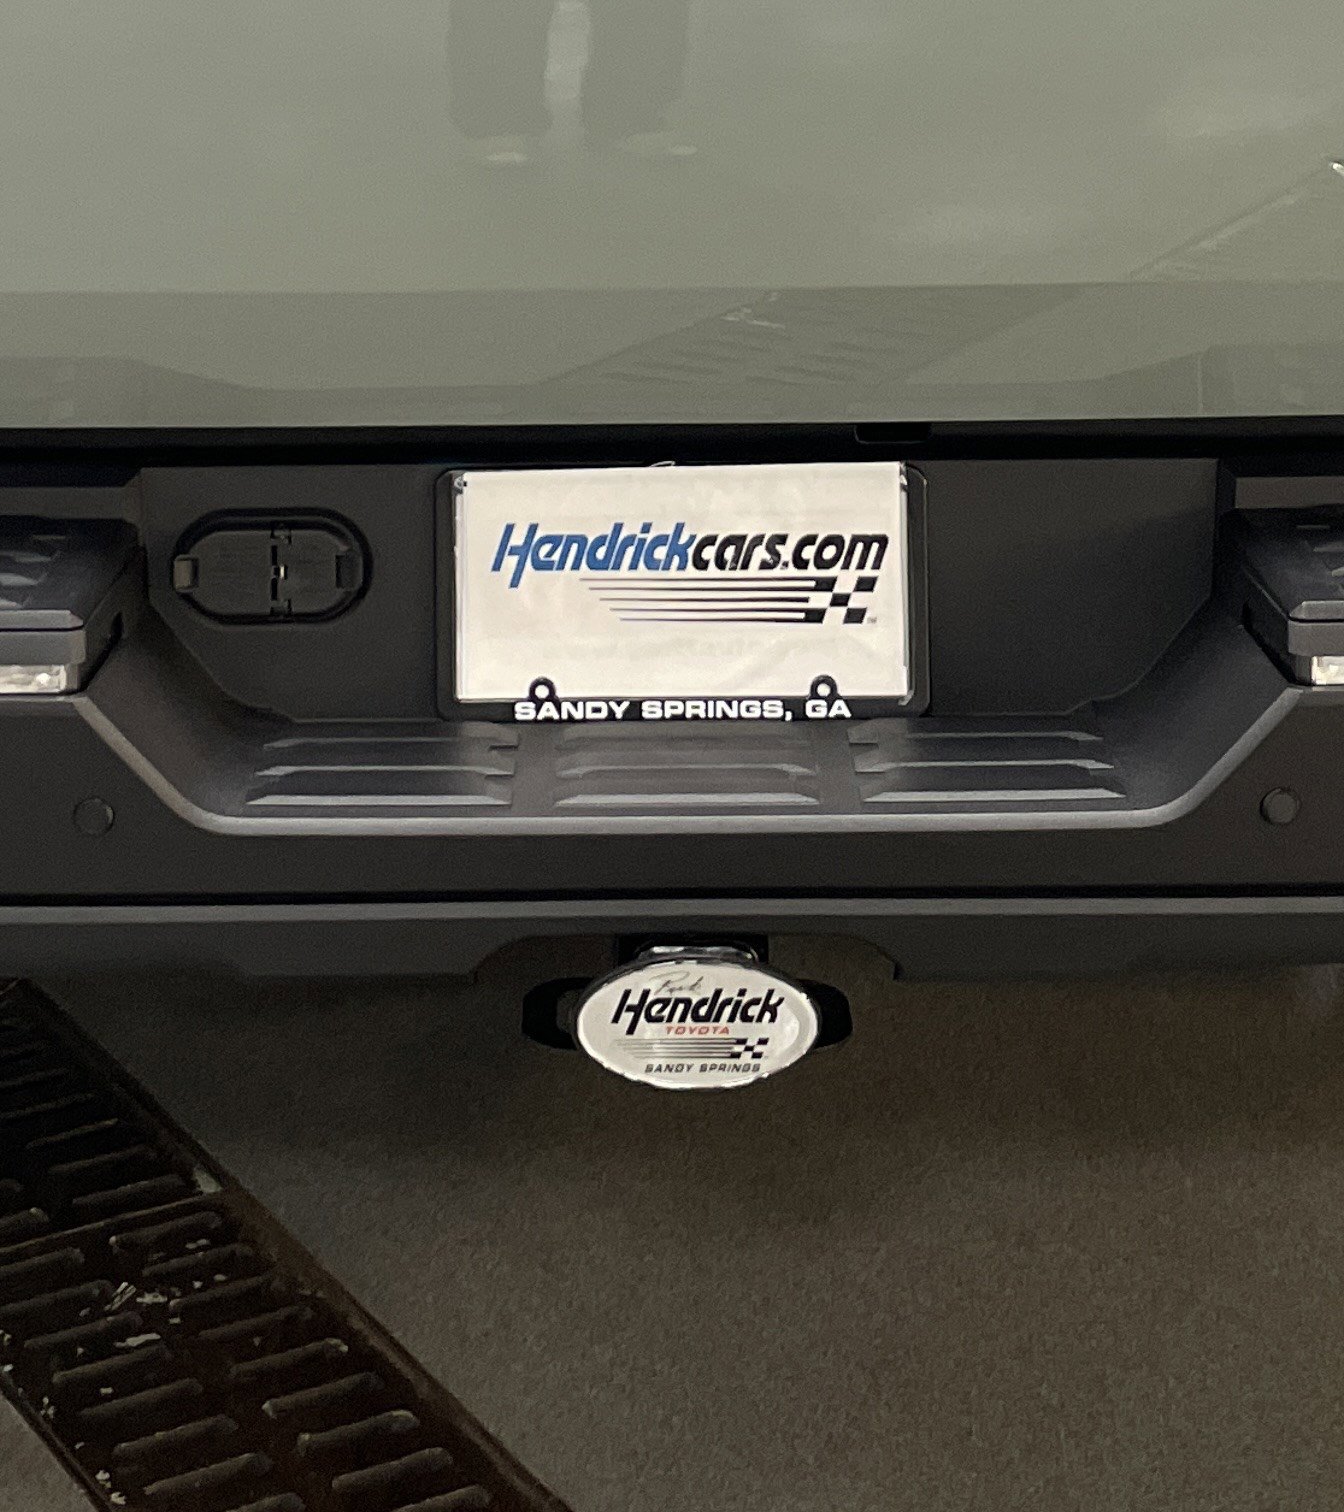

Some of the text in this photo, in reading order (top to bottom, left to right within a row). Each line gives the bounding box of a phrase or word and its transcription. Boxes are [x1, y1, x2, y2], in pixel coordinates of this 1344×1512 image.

[490, 521, 889, 589] Hendrickcars.com
[514, 698, 852, 722] SANDY SPRINGS, GA
[611, 988, 785, 1036] Hendrick
[666, 1025, 731, 1036] TOYOTA
[644, 1062, 761, 1074] SANDY SPRINGS
